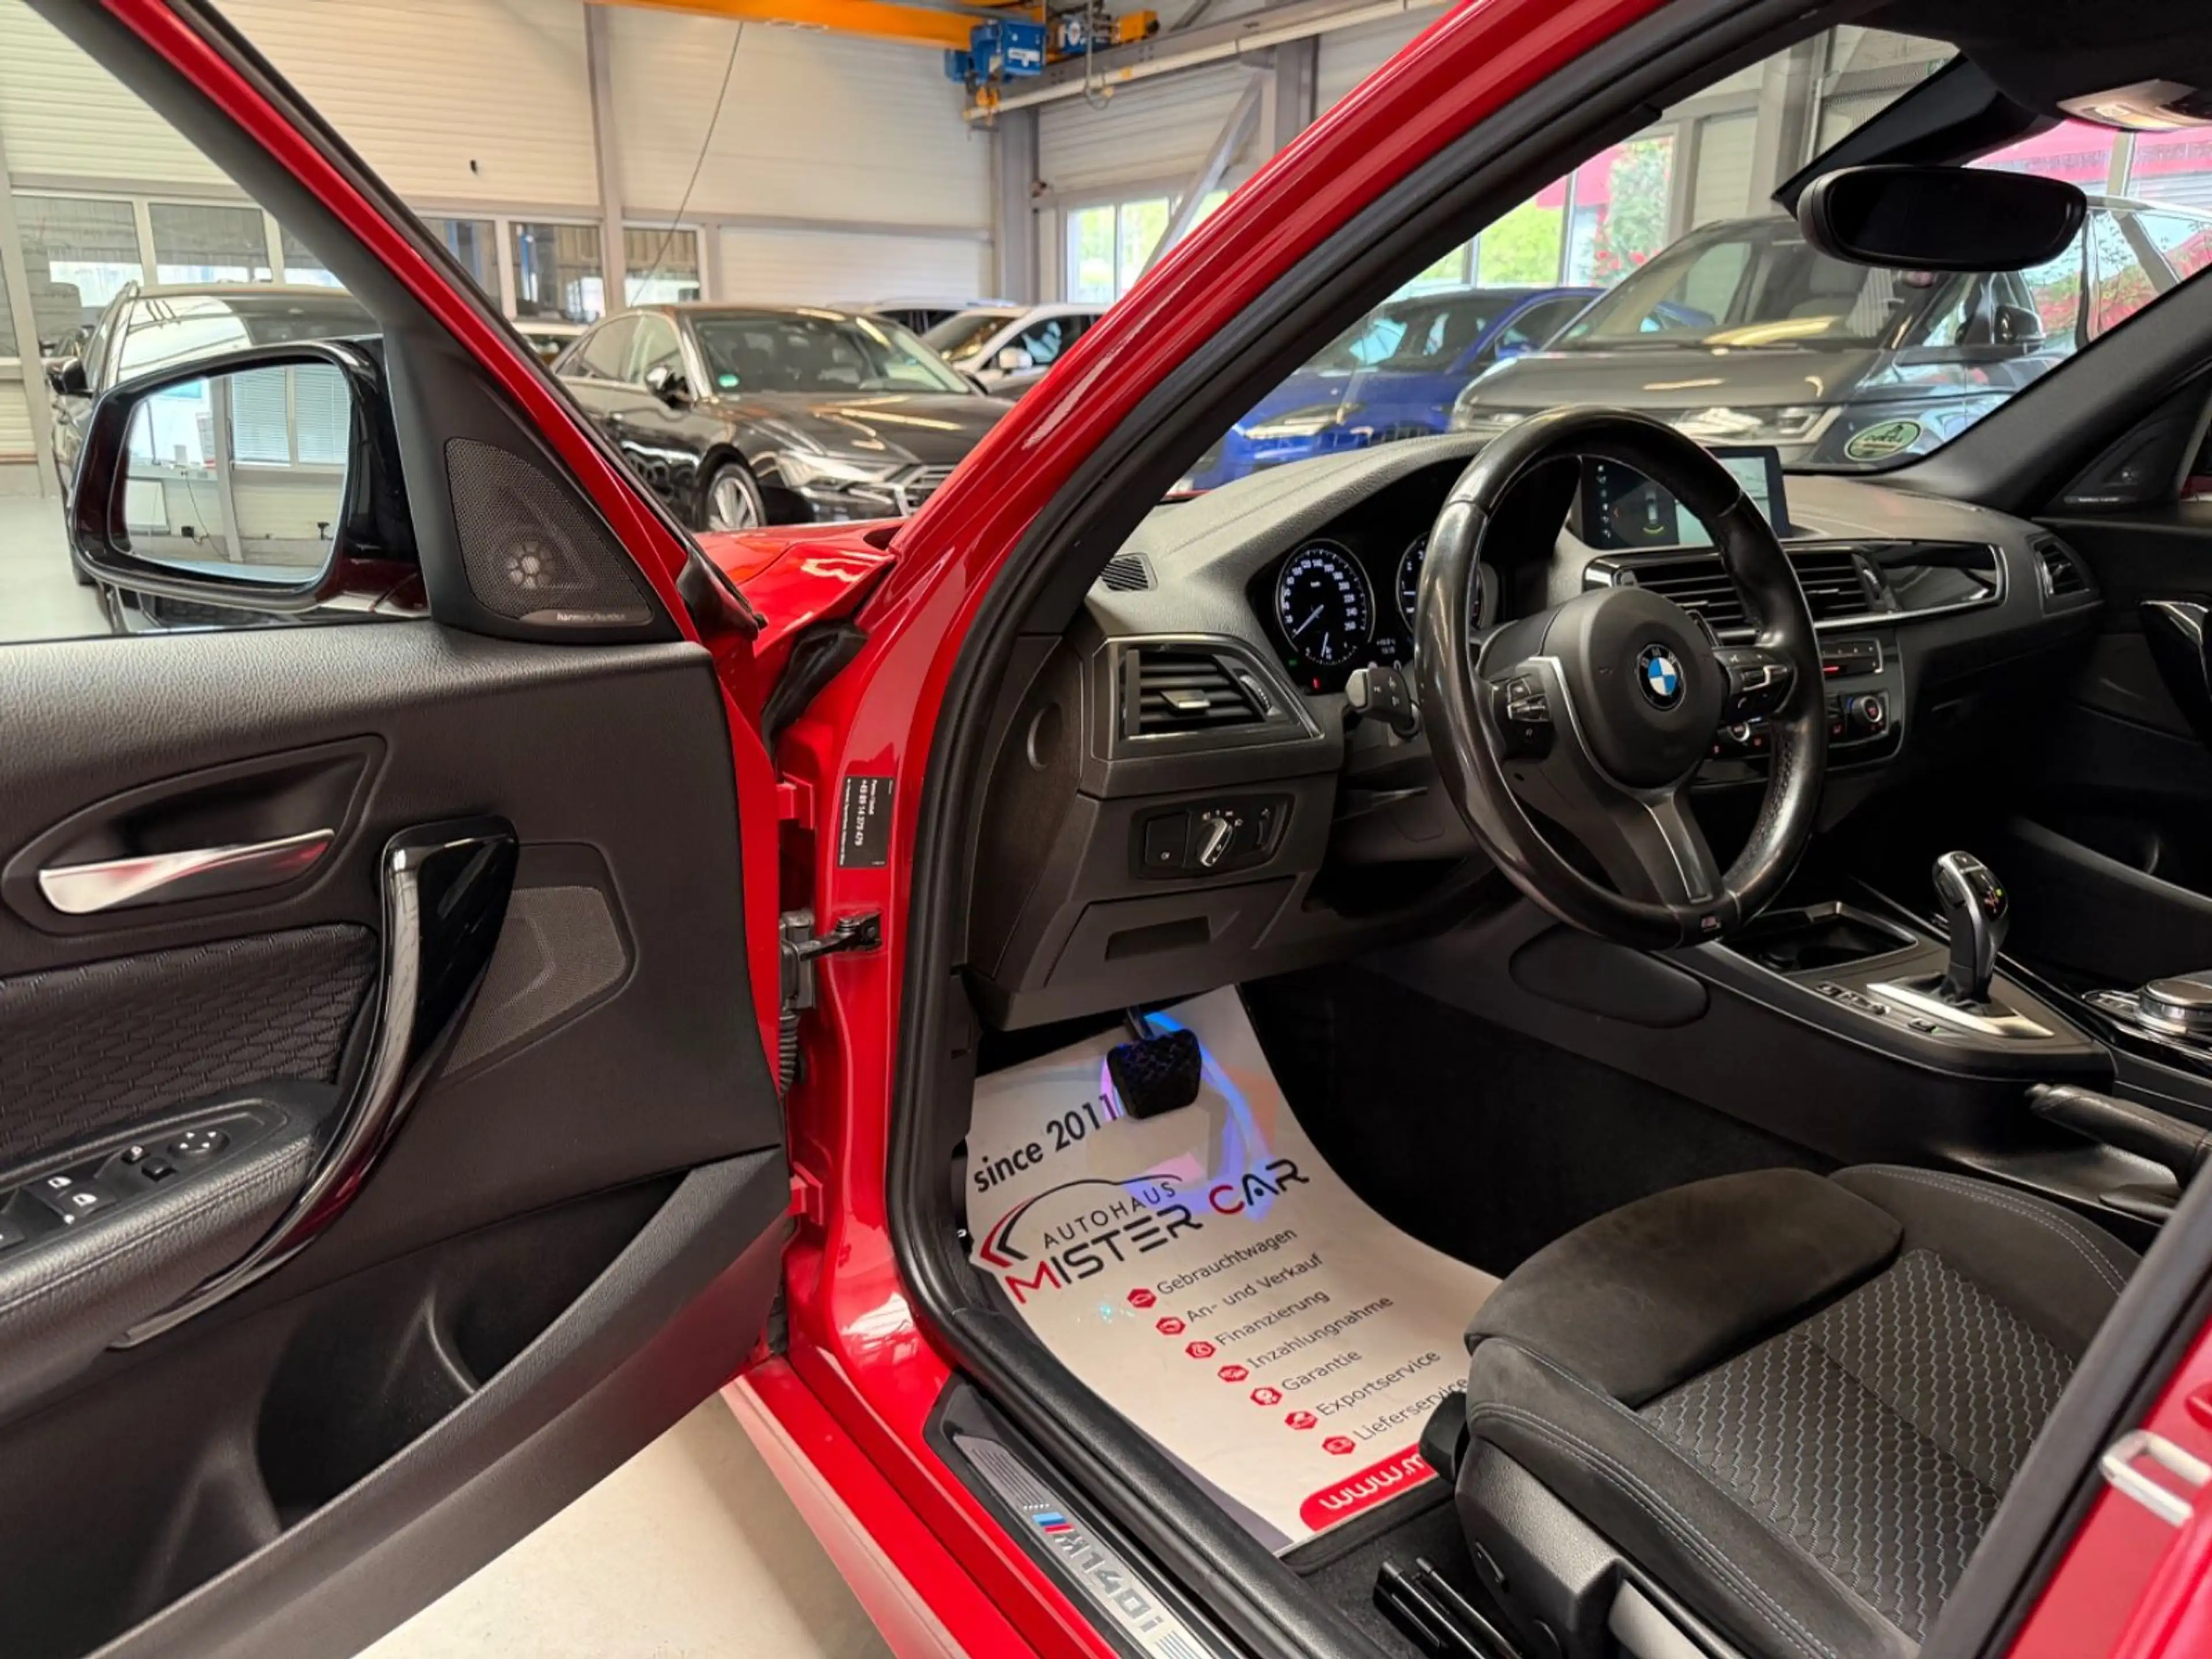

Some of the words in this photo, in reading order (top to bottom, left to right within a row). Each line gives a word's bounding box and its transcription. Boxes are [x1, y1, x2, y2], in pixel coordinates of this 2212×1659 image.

[974, 1142, 1044, 1192] since
[1046, 1093, 1117, 1153] 2011
[1004, 1203, 1203, 1304] MISTER
[1209, 1158, 1310, 1215] CAR
[1043, 1181, 1176, 1249] AUTOHAUS
[1157, 1229, 1298, 1294] Gebrauchtwagen
[1186, 1303, 1218, 1323] An-
[1222, 1283, 1258, 1306] und
[1255, 1251, 1324, 1289] Verkauf
[1214, 1289, 1331, 1346] Finanzierung
[1247, 1296, 1395, 1369] Inzahlungnahme
[1281, 1350, 1363, 1391] Garantie
[1316, 1349, 1442, 1416] Exportservice
